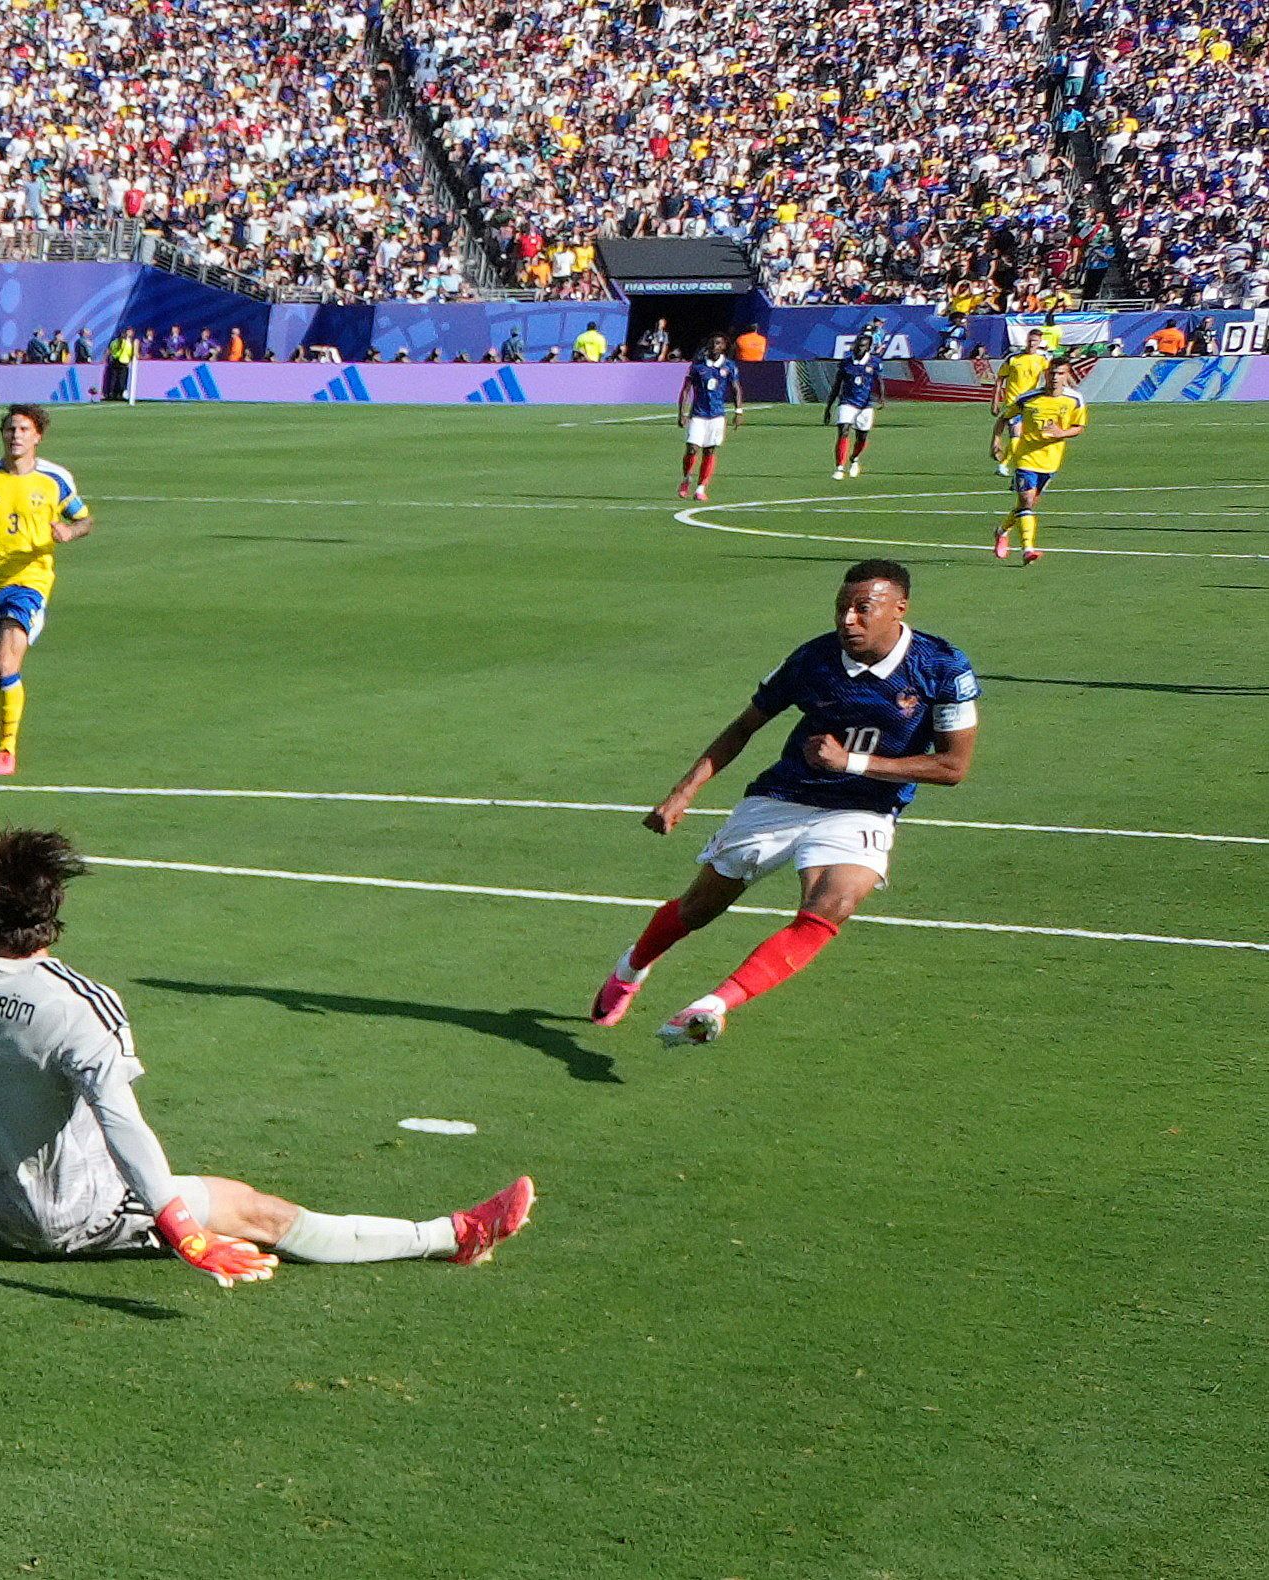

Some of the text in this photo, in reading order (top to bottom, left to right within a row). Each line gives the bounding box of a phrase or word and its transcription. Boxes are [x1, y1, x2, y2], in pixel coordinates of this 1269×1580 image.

[645, 282, 679, 292] WORLD
[679, 282, 698, 292] CUP
[7, 513, 21, 535] 3
[843, 727, 880, 755] 10
[857, 829, 887, 853] 10
